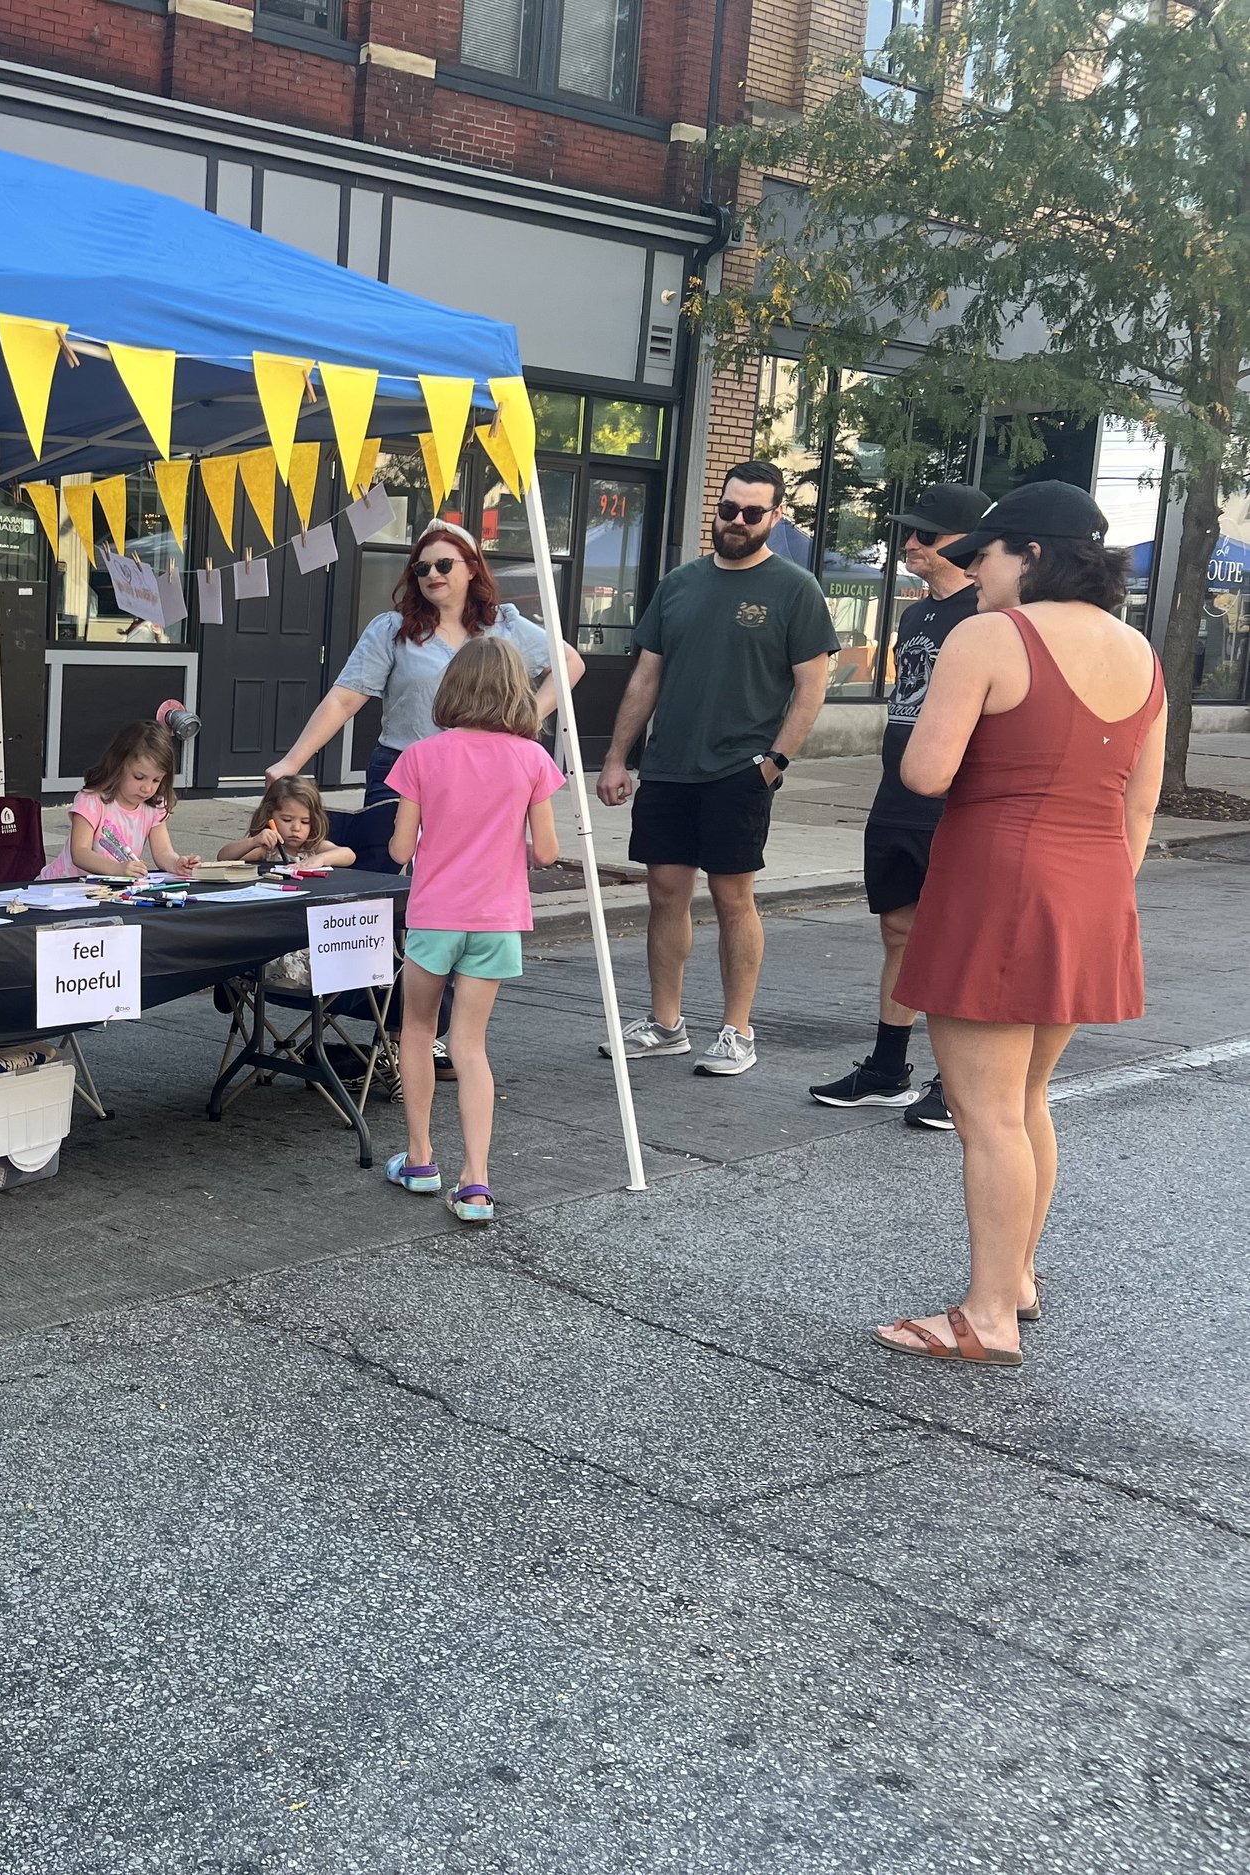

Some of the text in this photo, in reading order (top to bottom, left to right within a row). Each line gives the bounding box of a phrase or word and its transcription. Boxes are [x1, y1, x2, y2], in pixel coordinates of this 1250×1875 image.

[600, 494, 626, 517] 921
[1207, 559, 1244, 583] OUPE
[323, 914, 379, 929] about our
[73, 939, 104, 960] feel
[317, 934, 385, 954] community?
[56, 969, 121, 995] hopeful
